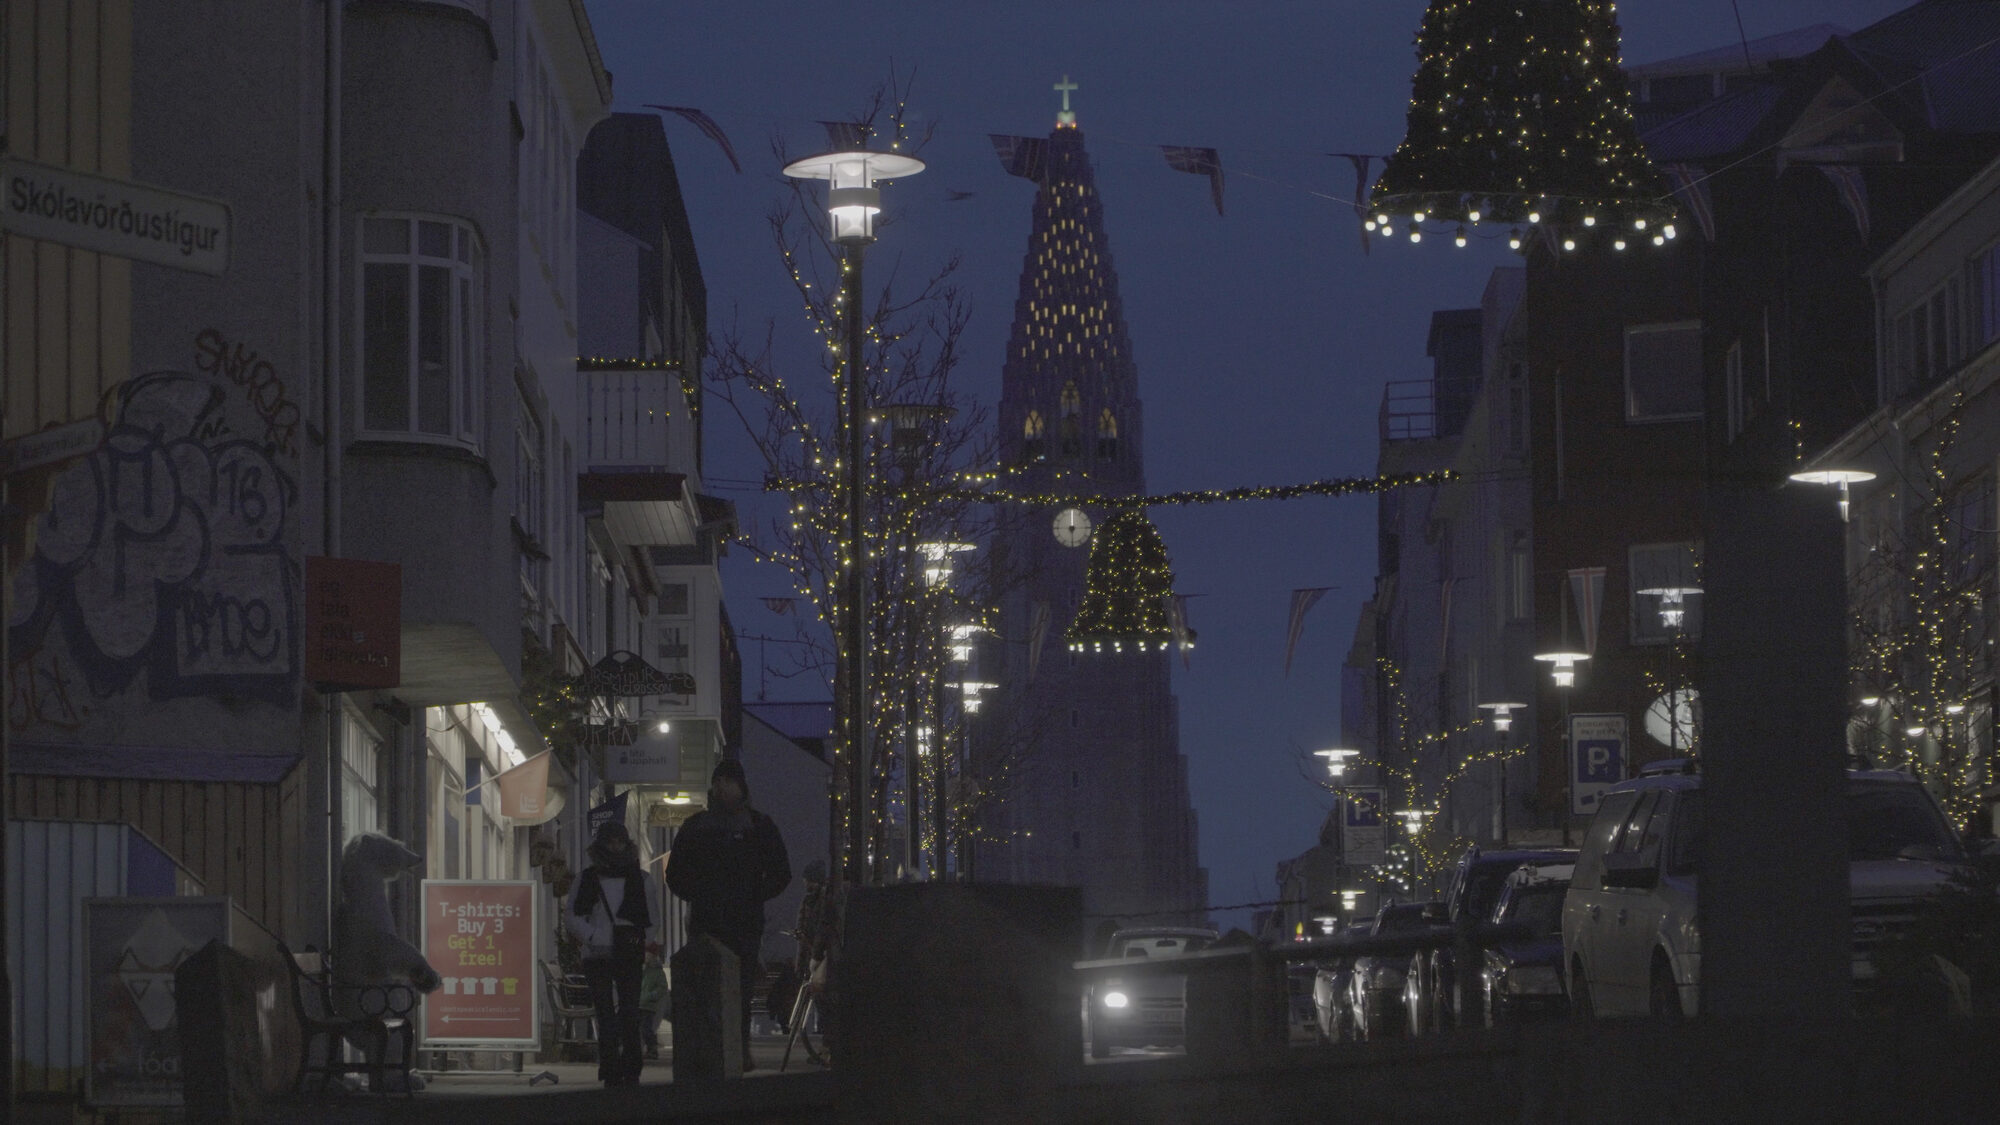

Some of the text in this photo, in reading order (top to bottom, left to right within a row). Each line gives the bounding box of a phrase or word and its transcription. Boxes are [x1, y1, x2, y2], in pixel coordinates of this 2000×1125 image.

[11, 176, 220, 255] Skólavörðustígur
[1588, 746, 1611, 776] P
[592, 811, 614, 820] SHOP
[440, 902, 521, 918] T-shirts:
[457, 919, 504, 937] Buy 3
[447, 935, 495, 950] Get 1
[458, 950, 503, 966] free!
